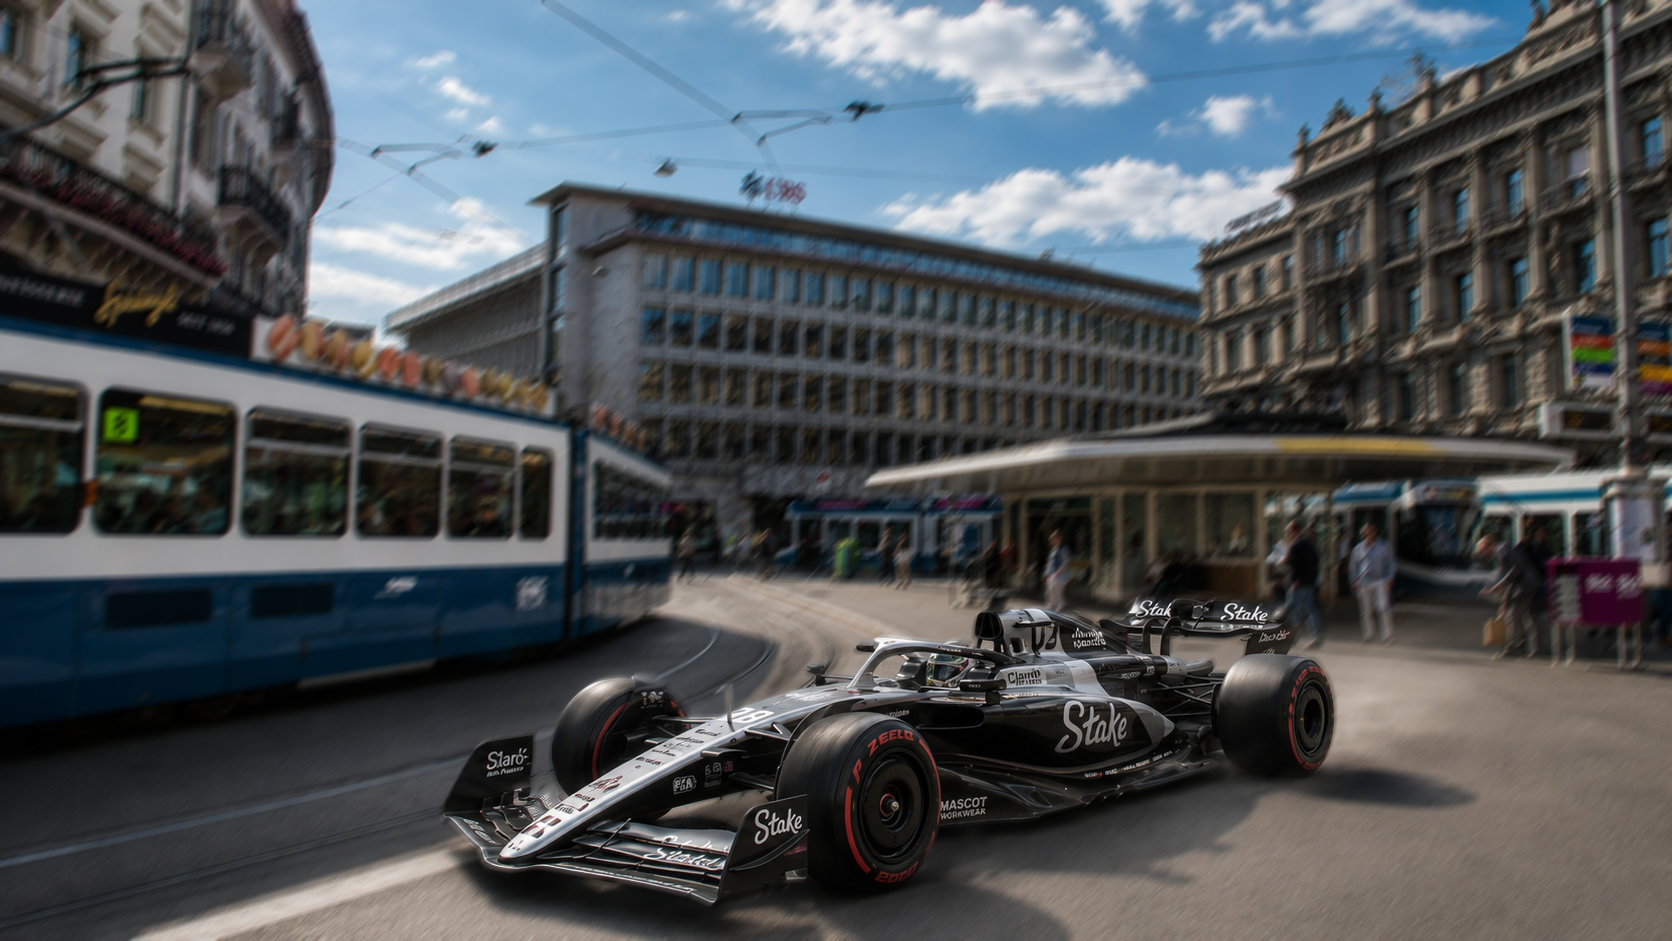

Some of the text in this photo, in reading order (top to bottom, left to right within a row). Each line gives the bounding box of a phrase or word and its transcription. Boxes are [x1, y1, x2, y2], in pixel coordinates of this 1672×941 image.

[1135, 600, 1172, 619] Stak
[1220, 602, 1269, 624] Stake
[1054, 700, 1127, 753] Stake
[940, 796, 988, 812] MASCOT
[940, 807, 986, 820] WORKWEAR
[754, 808, 803, 845] Stake
